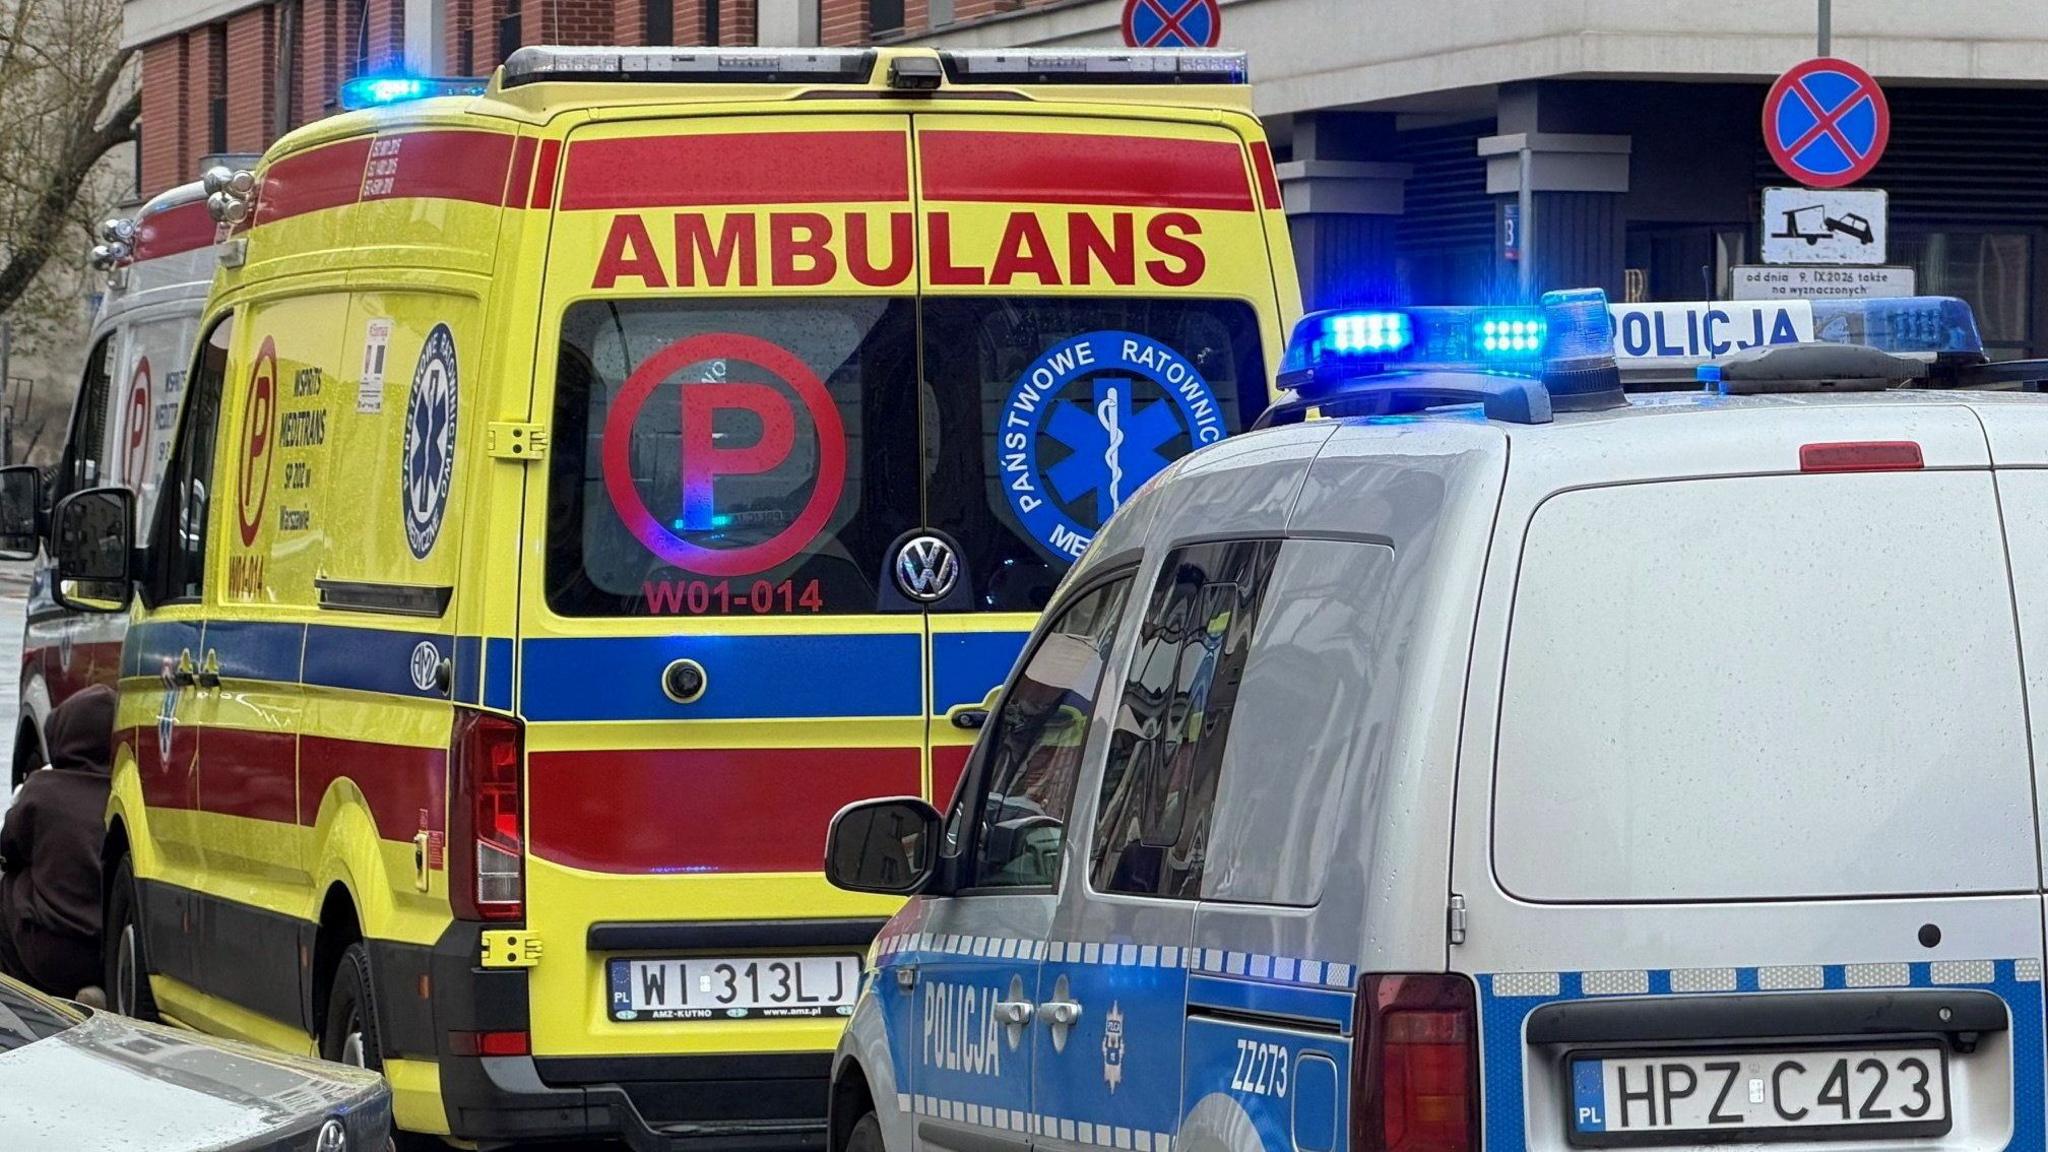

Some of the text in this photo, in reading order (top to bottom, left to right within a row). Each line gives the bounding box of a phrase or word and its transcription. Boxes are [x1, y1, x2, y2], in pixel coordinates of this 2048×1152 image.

[591, 211, 1206, 288] AMBULANS
[1746, 272, 1761, 282] od
[1763, 272, 1789, 282] dnia
[1858, 271, 1888, 282] także
[1772, 285, 1867, 296] na wyznaczonych
[1121, 339, 1221, 444] RATOWNIC
[1000, 341, 1096, 513] PAŃSTWOWE
[682, 383, 796, 530] P
[642, 578, 823, 614] W01-014
[613, 991, 630, 1004] PL
[641, 961, 843, 1006] WI 313LJ
[652, 1009, 713, 1018] AMZ-KUTNO
[763, 1007, 822, 1017] www.amz.pl
[923, 981, 1000, 1077] POLICJA
[1230, 1038, 1288, 1098] ZZ273
[1617, 1057, 1932, 1127] HPZ C423
[1579, 1107, 1601, 1124] PL
